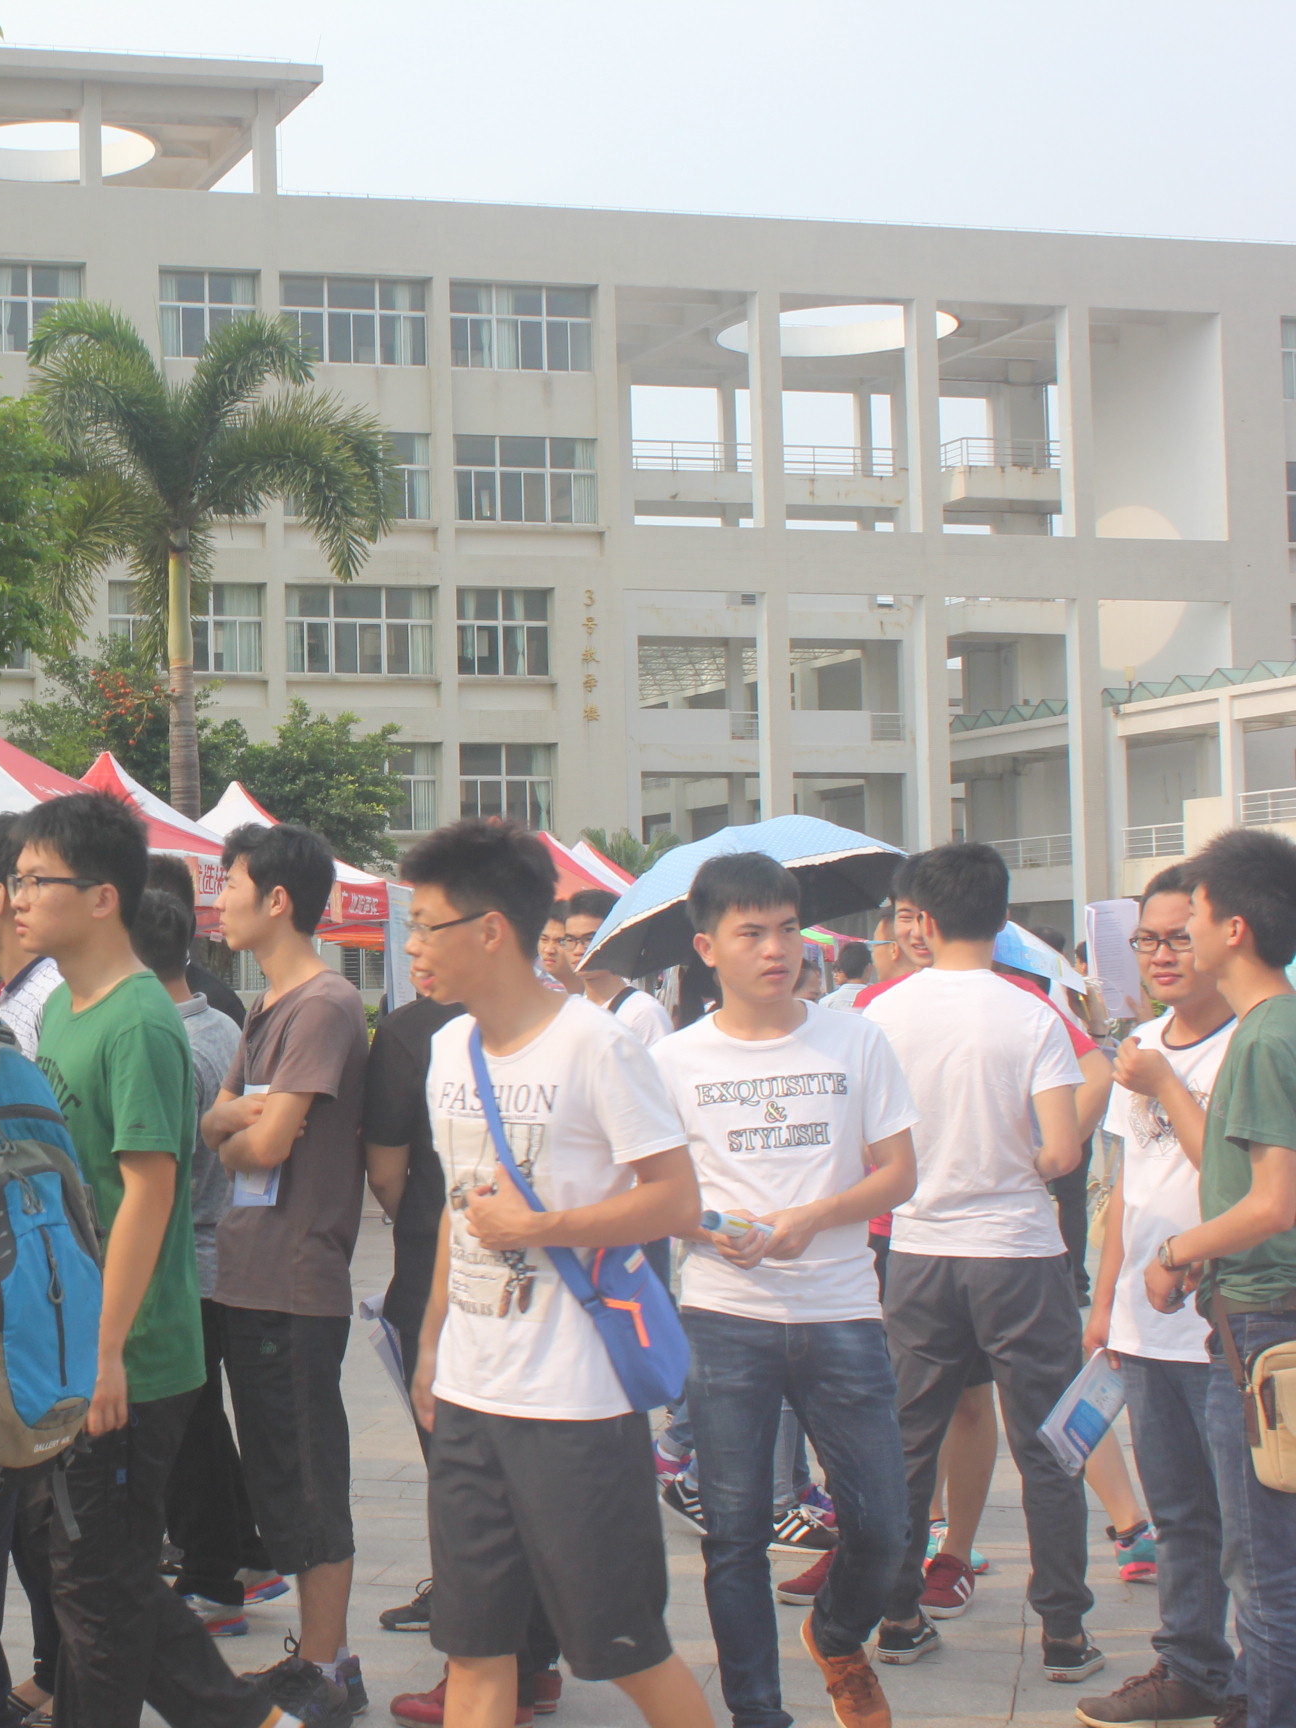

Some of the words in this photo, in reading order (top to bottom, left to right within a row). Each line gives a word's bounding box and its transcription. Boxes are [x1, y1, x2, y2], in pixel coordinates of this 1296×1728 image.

[581, 588, 600, 721] 3号教学楼
[694, 1072, 848, 1107] EXQUISITE
[764, 1100, 787, 1124] &
[727, 1122, 831, 1153] STYLISH
